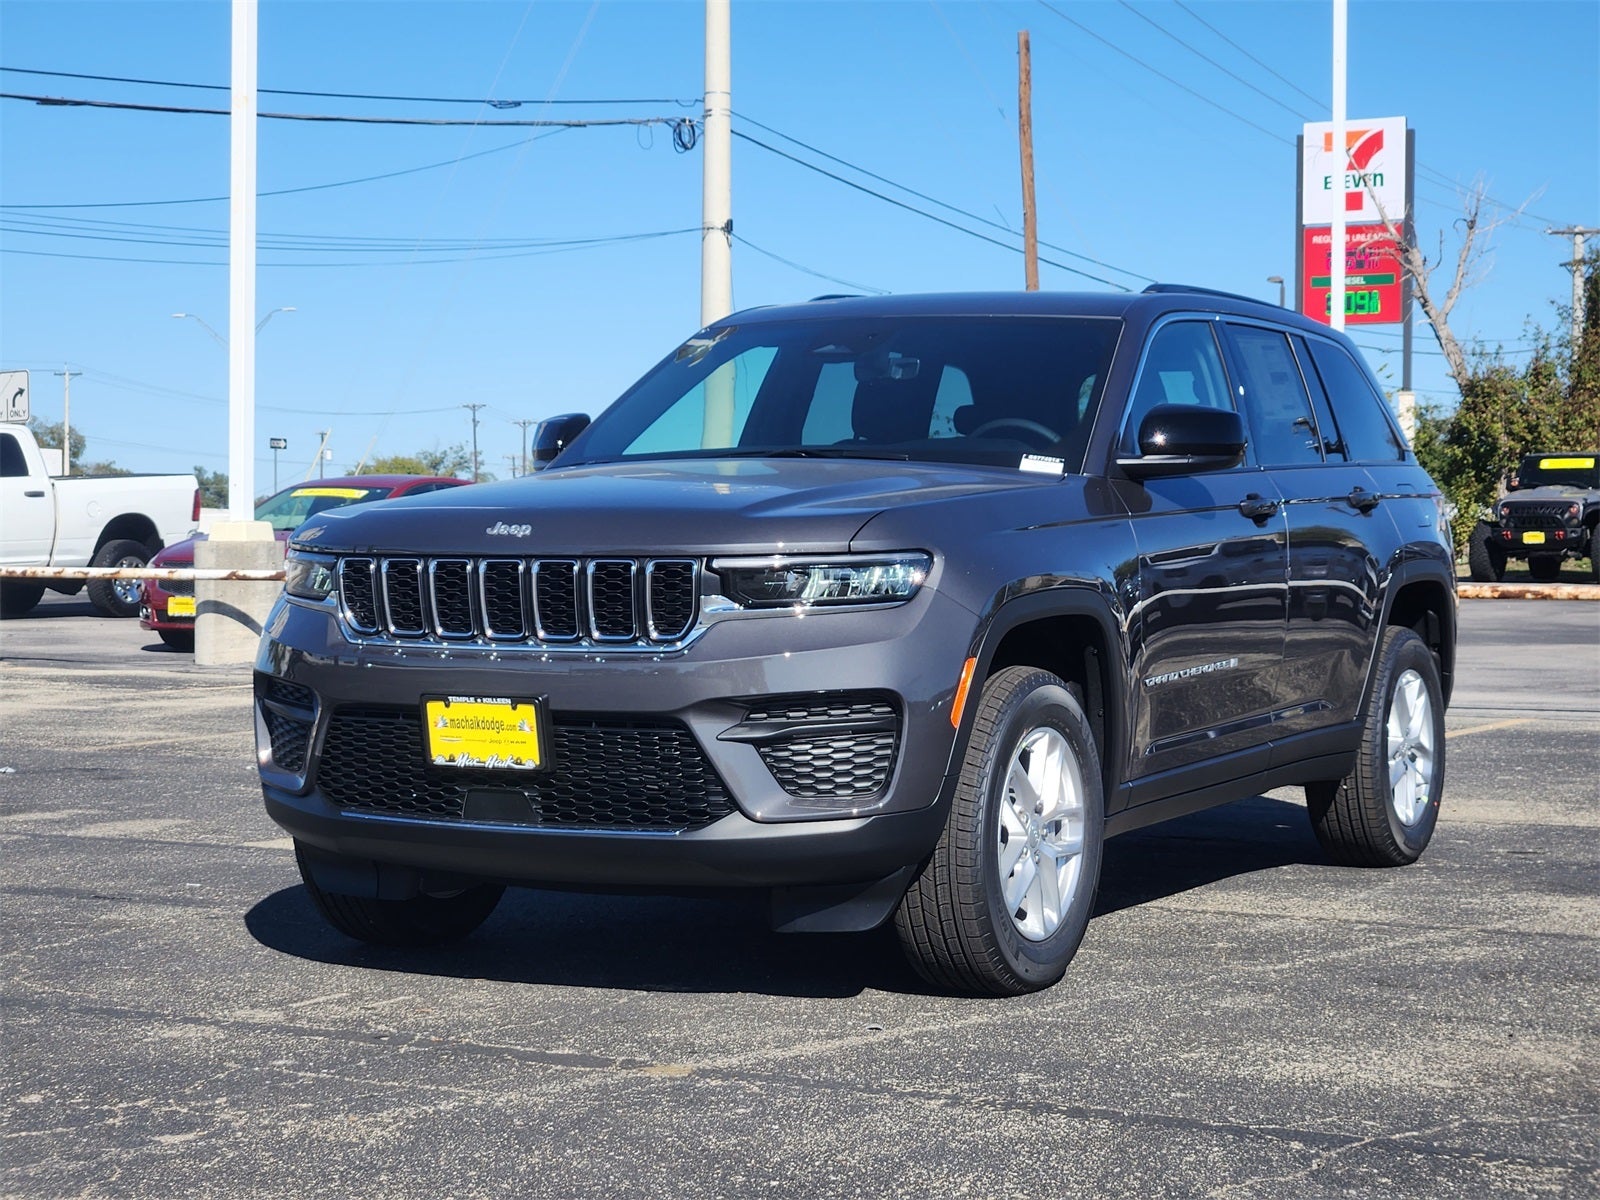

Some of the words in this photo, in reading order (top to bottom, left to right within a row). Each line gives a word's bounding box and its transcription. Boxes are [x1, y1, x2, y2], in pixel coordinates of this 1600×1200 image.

[9, 409, 27, 418] ONLY
[486, 521, 532, 538] Jeep
[1144, 671, 1179, 687] GRAND
[1179, 659, 1231, 678] CHEROKEE
[449, 715, 518, 734] machaikdodge.com
[456, 752, 480, 768] Mac
[485, 753, 515, 769] Haik
